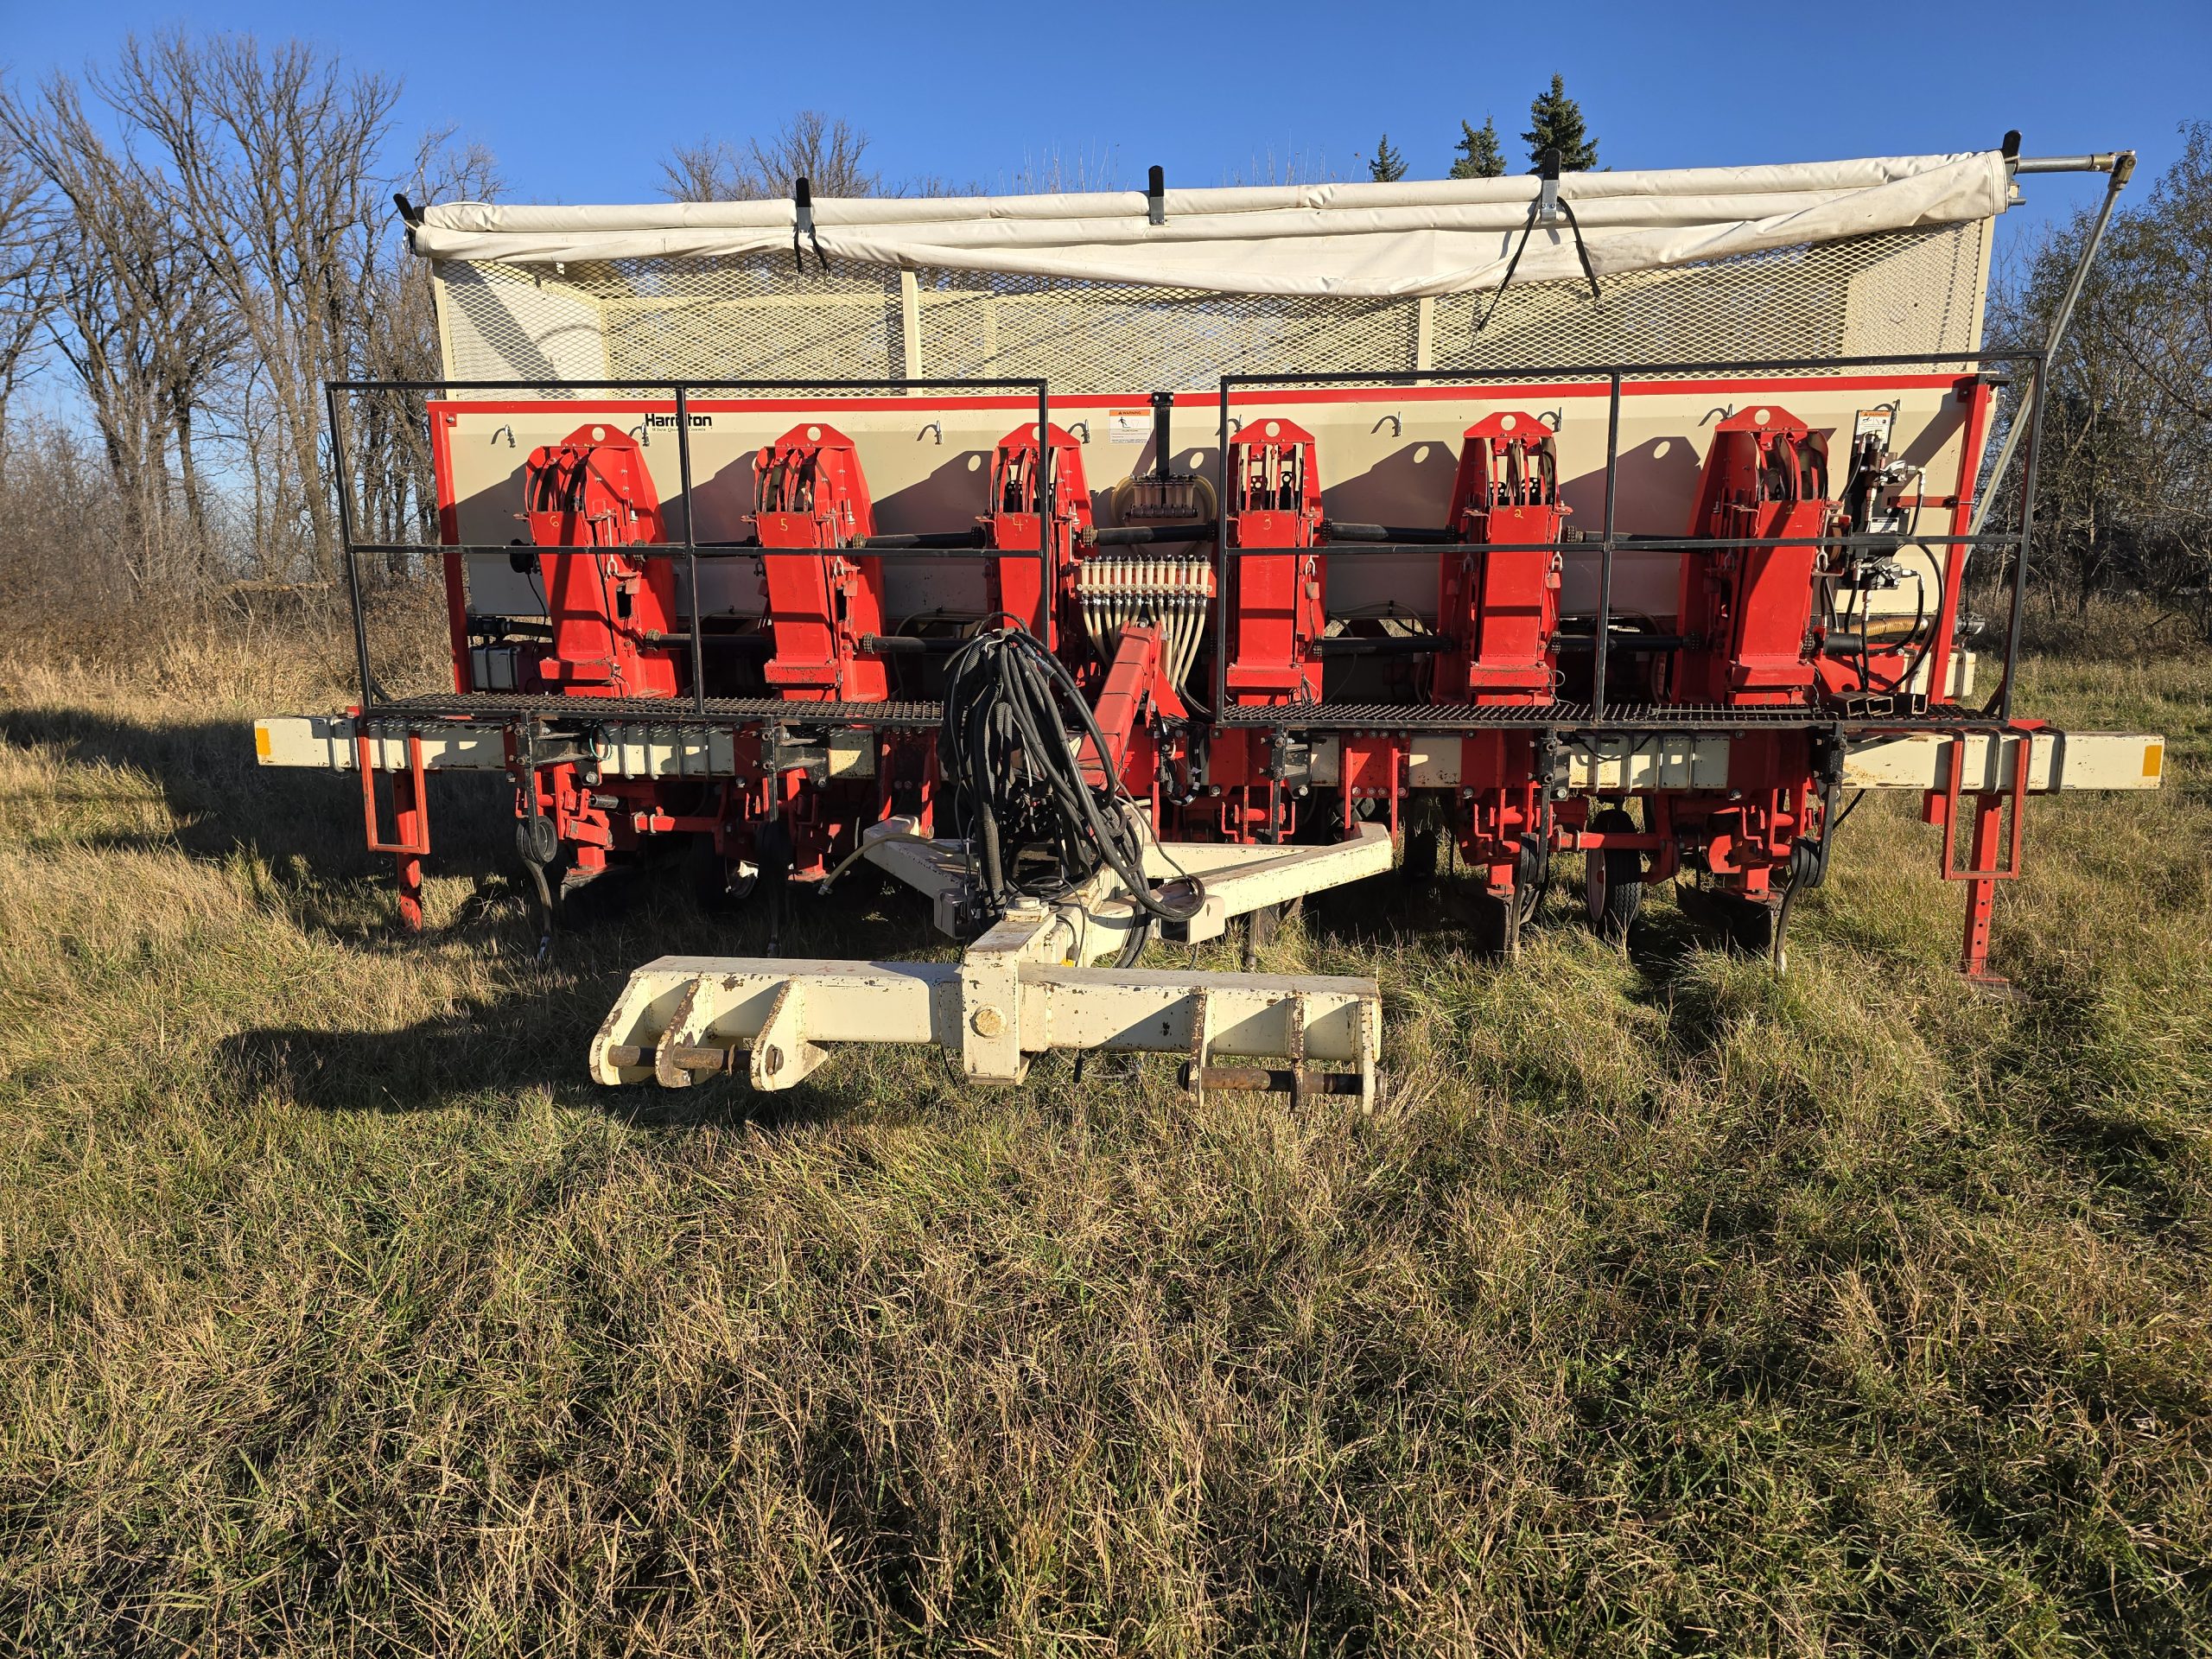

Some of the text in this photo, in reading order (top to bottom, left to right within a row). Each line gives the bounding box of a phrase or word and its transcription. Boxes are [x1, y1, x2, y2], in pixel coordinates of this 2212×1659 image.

[645, 413, 712, 427] Harriton
[1514, 508, 1524, 518] 2
[1785, 504, 1796, 515] 1
[550, 515, 560, 527] 6
[779, 518, 788, 531] 5
[1012, 517, 1024, 531] 4
[1263, 513, 1272, 531] 3
